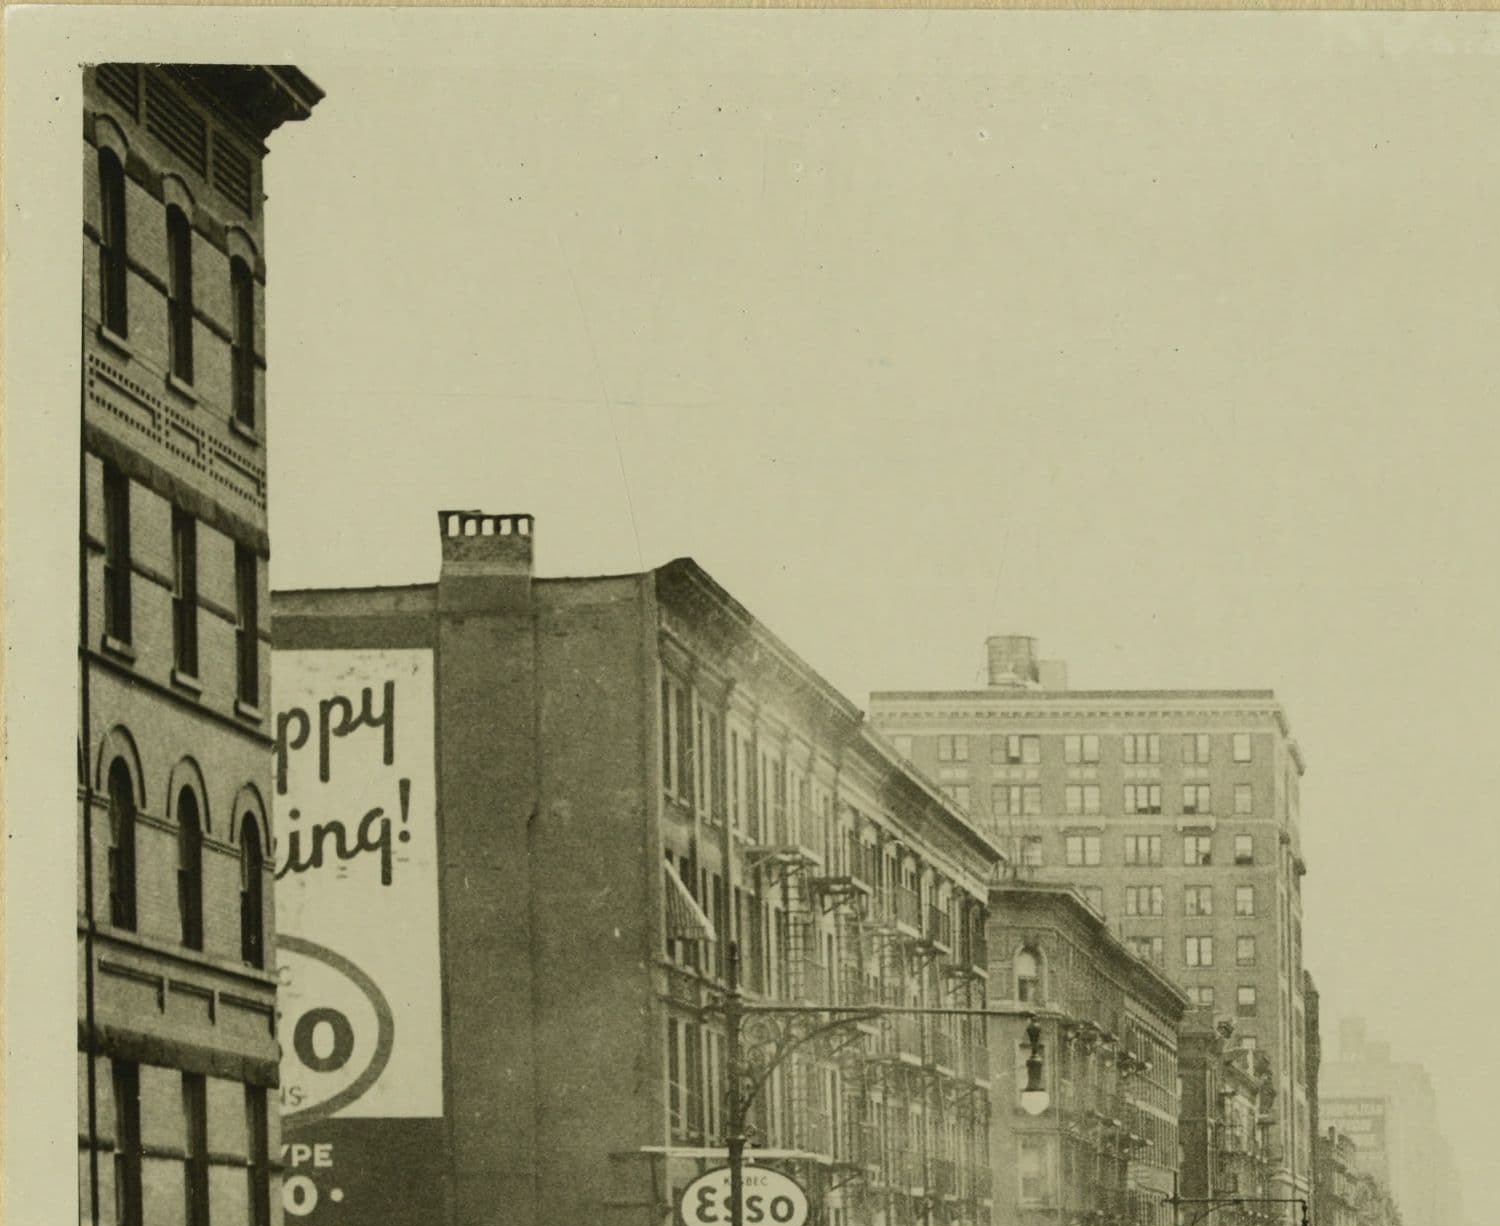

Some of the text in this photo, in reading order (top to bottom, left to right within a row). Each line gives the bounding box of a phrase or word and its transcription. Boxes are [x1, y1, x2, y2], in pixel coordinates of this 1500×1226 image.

[272, 680, 395, 795] ppy
[273, 778, 411, 886] ing!
[723, 1176, 768, 1186] KBEC
